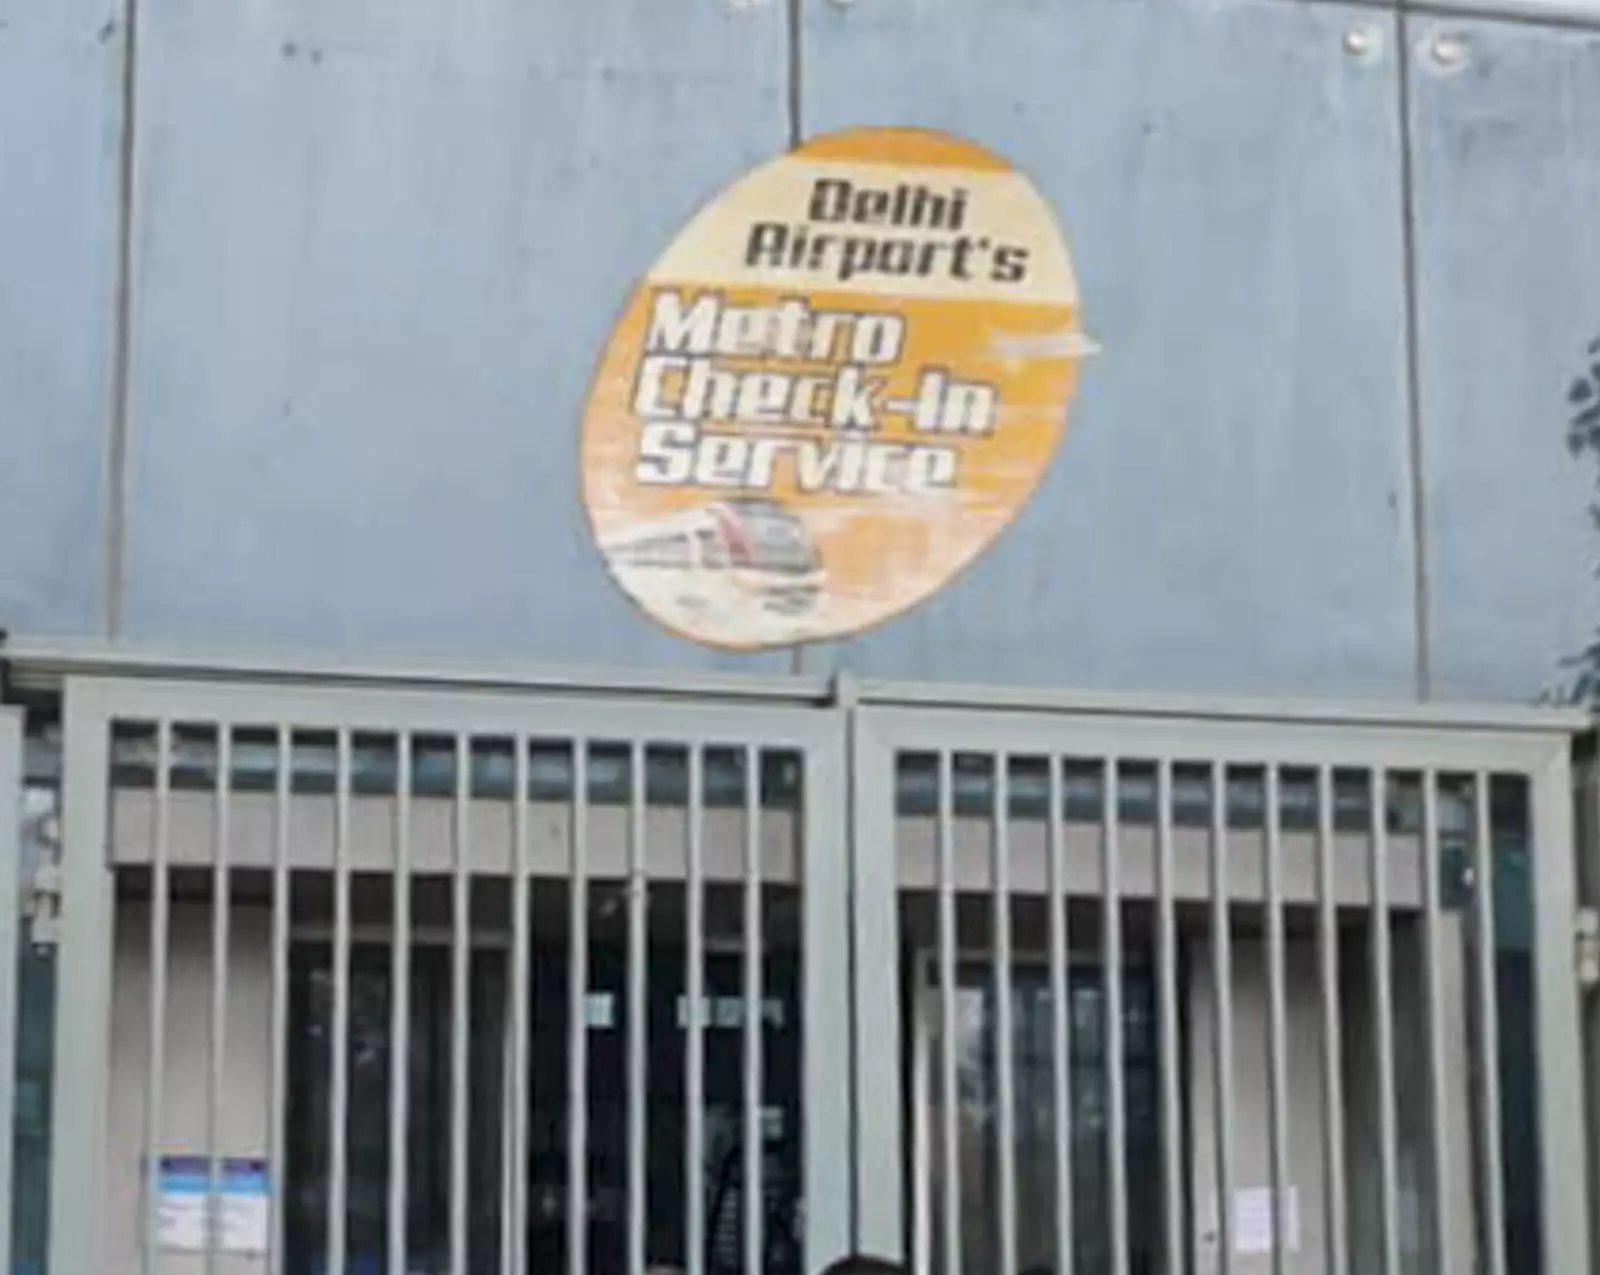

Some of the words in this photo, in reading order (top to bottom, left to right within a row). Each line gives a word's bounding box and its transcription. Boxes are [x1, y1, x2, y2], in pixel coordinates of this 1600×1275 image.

[808, 176, 970, 232] Delhi
[744, 221, 1031, 284] Airport's
[644, 286, 906, 366] Metro
[634, 354, 1000, 437] Check-In
[634, 420, 960, 496] Service
